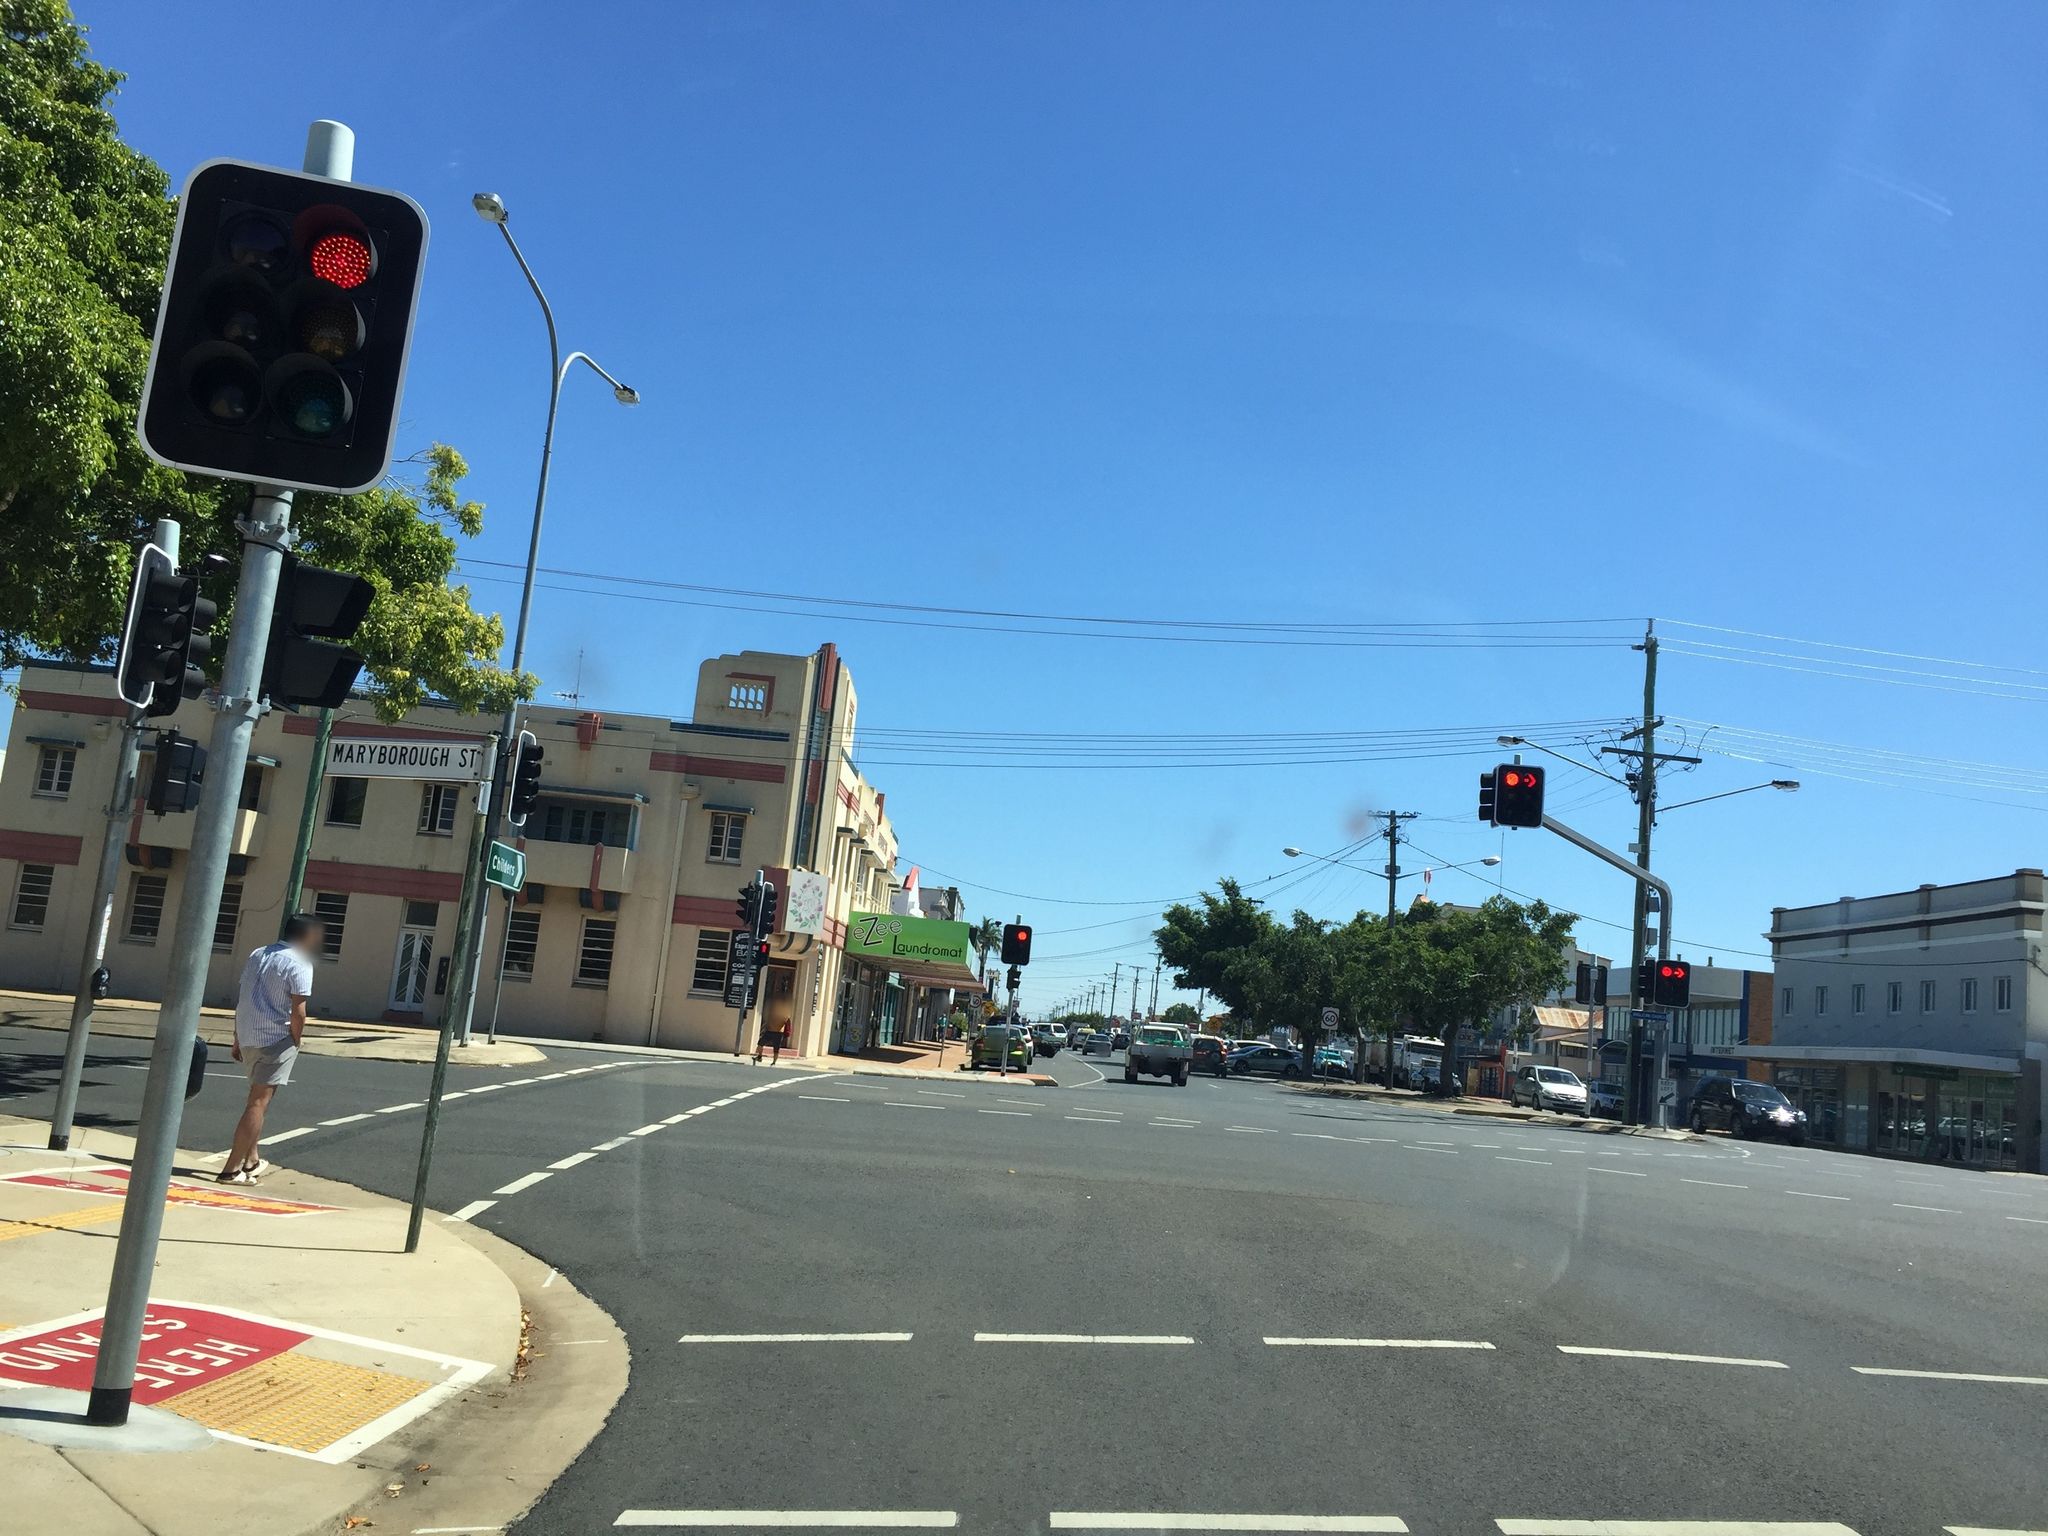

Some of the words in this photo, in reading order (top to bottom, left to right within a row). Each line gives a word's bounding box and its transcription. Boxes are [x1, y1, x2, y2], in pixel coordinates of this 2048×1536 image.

[332, 743, 450, 767] MARYBOROUGH
[458, 748, 478, 768] ST
[892, 935, 963, 958] Laundromat
[1325, 1014, 1336, 1023] 60
